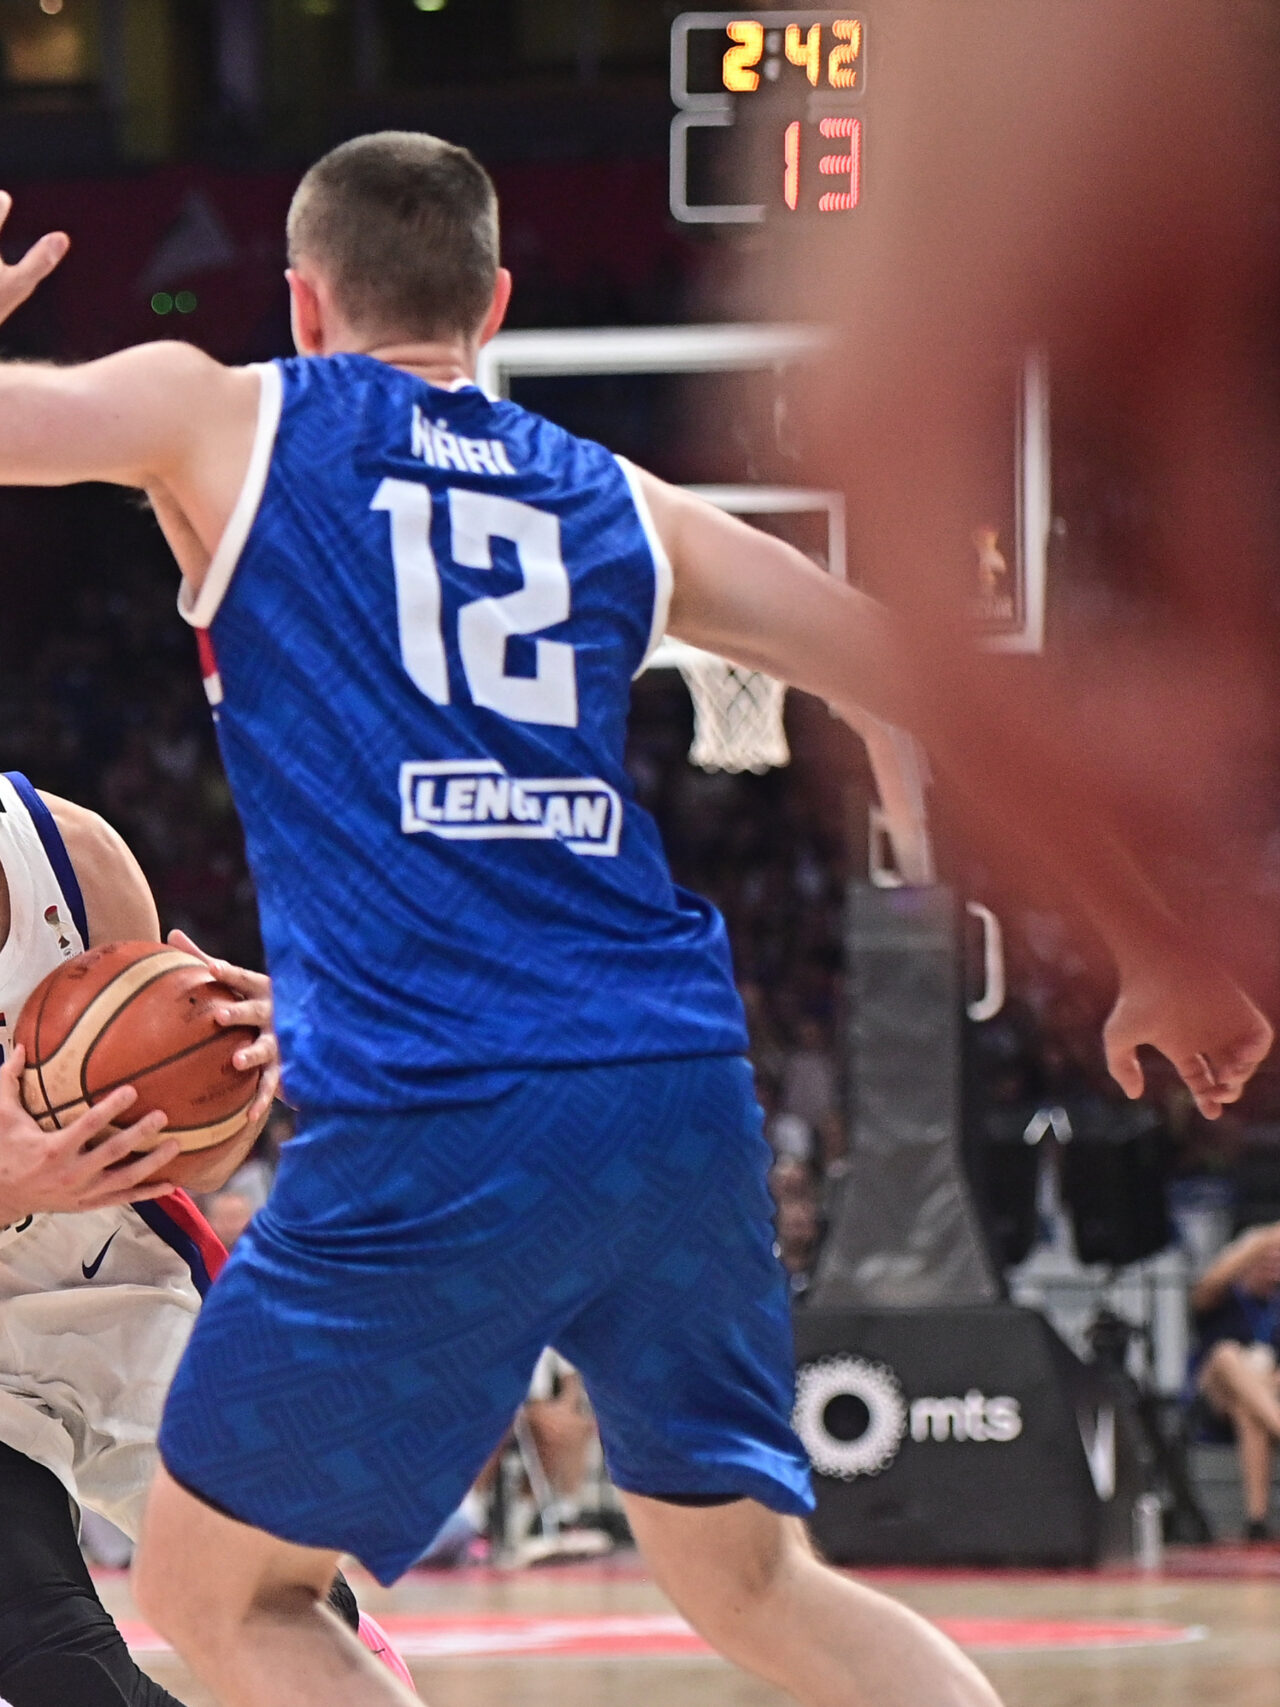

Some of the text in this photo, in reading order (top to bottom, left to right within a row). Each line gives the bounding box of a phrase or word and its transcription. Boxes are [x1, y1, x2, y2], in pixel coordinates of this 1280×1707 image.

[723, 20, 861, 92] 2:42
[785, 118, 861, 211] 13
[370, 477, 577, 728] 12
[910, 1389, 1022, 1442] mts
